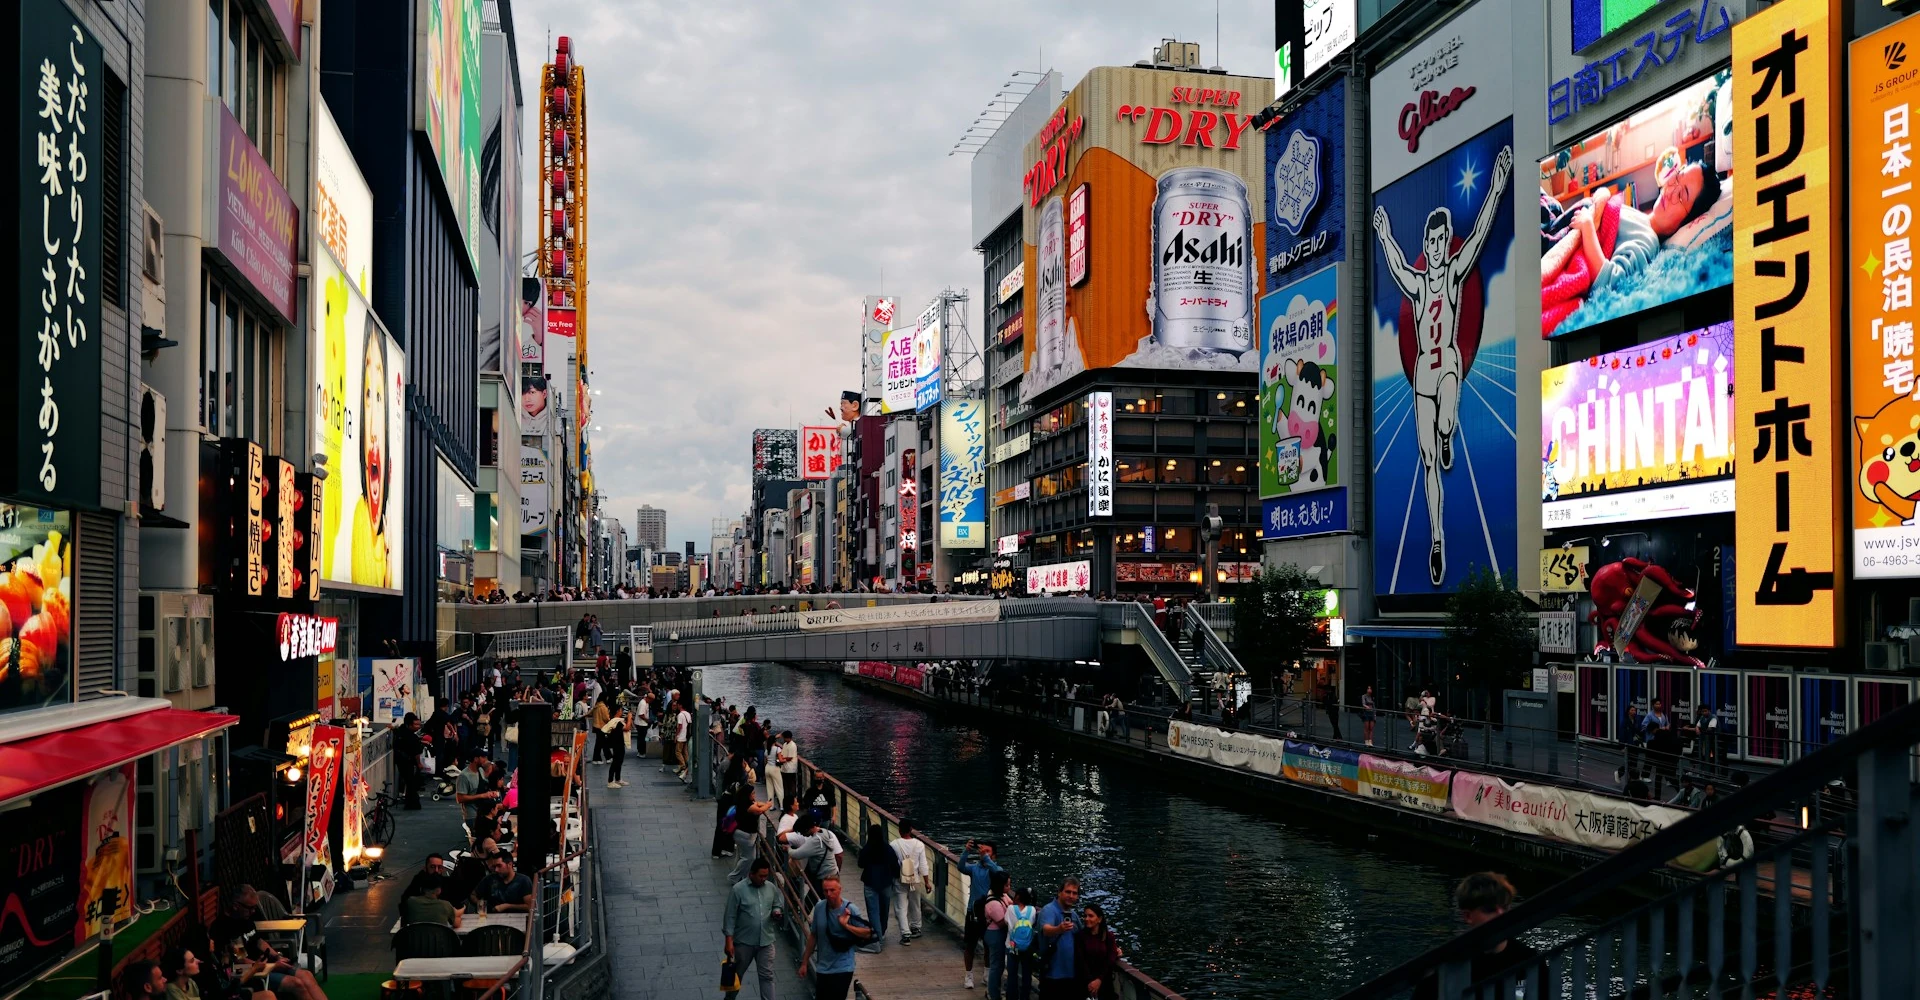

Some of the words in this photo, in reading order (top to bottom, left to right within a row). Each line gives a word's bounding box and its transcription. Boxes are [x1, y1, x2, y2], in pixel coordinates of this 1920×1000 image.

[1548, 4, 1731, 126] 日商エステム
[1873, 82, 1884, 94] JS
[1886, 68, 1918, 88] GROUP
[1170, 86, 1241, 107] SUPER
[1398, 86, 1476, 153] Glico
[67, 24, 88, 348] こだわりたい
[227, 135, 262, 213] LONG
[265, 182, 295, 248] DINH
[1189, 202, 1219, 211] SUPER
[227, 187, 256, 235] VIETNAM
[258, 223, 293, 277] RESTAURANT
[1163, 229, 1242, 269] Asahi
[1269, 230, 1327, 274] 雪印メグミルク
[38, 58, 63, 491] 美味しさがある
[1193, 270, 1214, 285] 生
[1180, 297, 1228, 308] スーパードライ
[1751, 28, 1827, 606] オリエントホーム
[1272, 310, 1323, 354] 牧場の朝
[1428, 294, 1443, 370] グリコ
[888, 378, 915, 391] プレゼント
[1098, 411, 1109, 451] 本場の味
[1098, 456, 1110, 512] かに道楽
[250, 447, 261, 592] たこ焼き
[958, 528, 968, 536] BX
[1548, 508, 1571, 521] 天気予報
[310, 481, 321, 598] 串かつ
[1713, 546, 1720, 577] 2F
[1045, 569, 1068, 588] かに道楽
